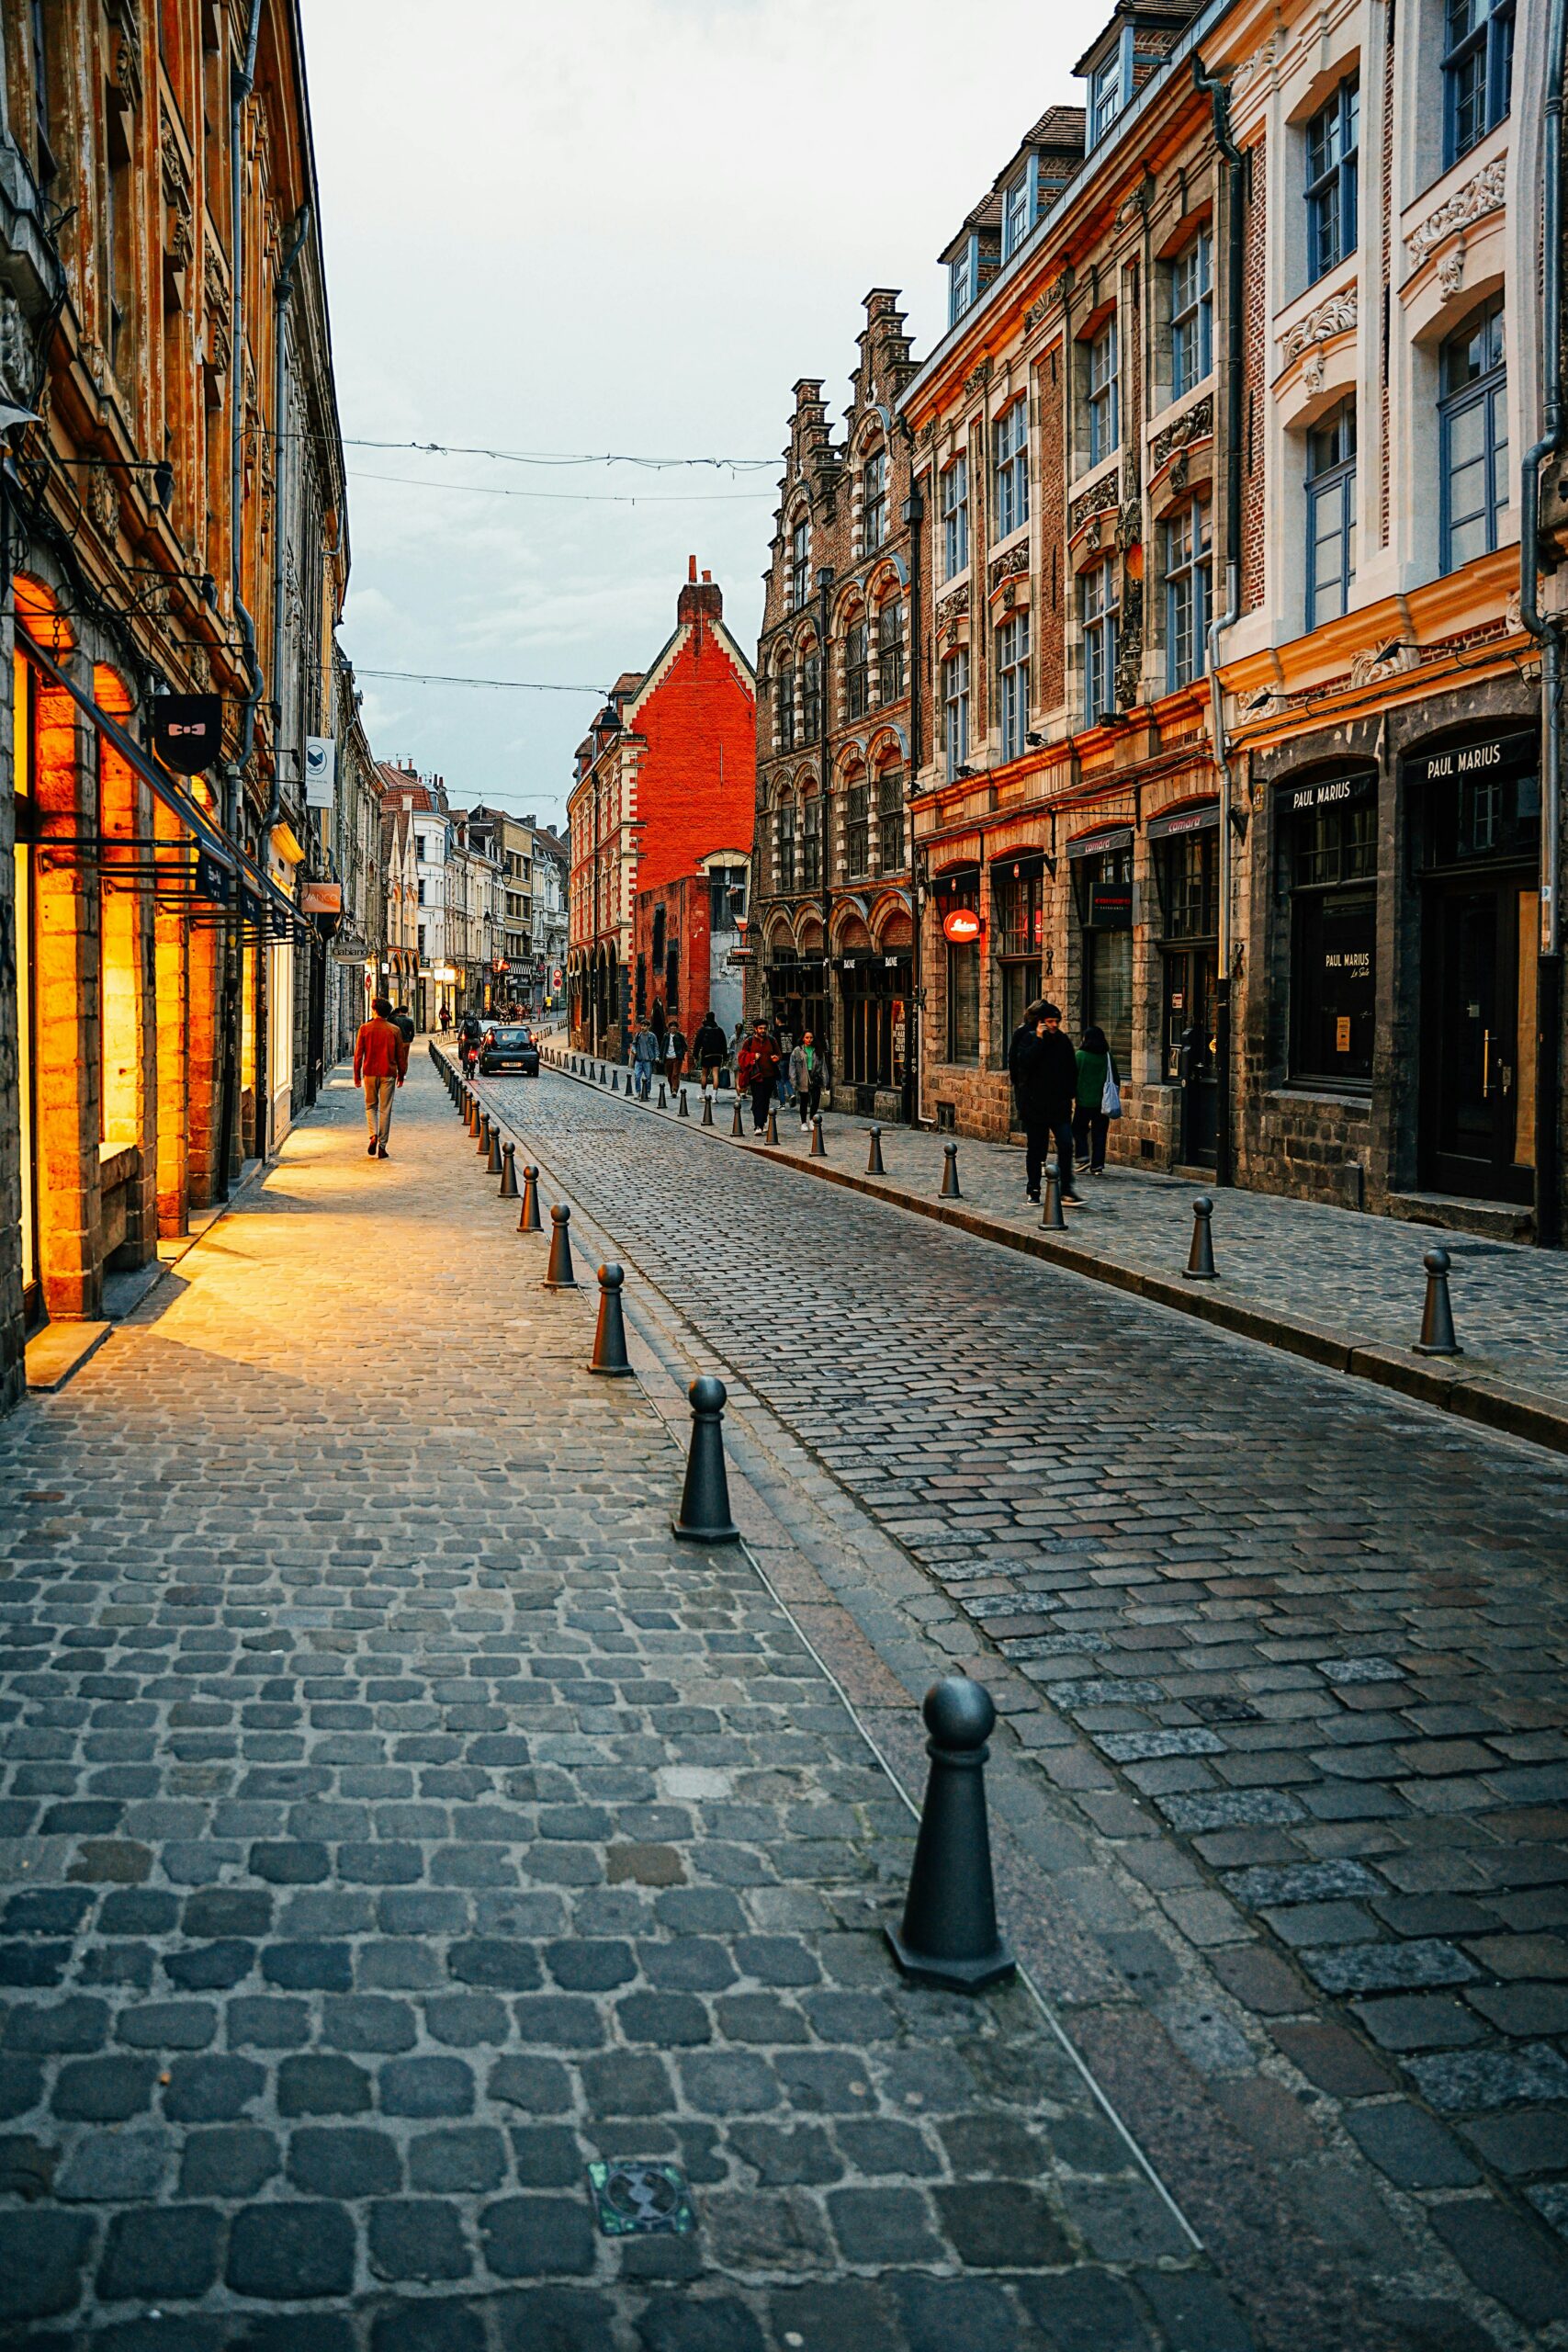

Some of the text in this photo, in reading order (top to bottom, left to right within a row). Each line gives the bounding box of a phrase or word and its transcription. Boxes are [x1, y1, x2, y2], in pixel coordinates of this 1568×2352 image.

[1427, 744, 1501, 779] PAUL MARIUS
[1293, 781, 1350, 809] PAUL MARIUS
[951, 919, 977, 933] Leica
[333, 947, 367, 956] Gabiano
[1325, 953, 1370, 967] PAUL MARIUS
